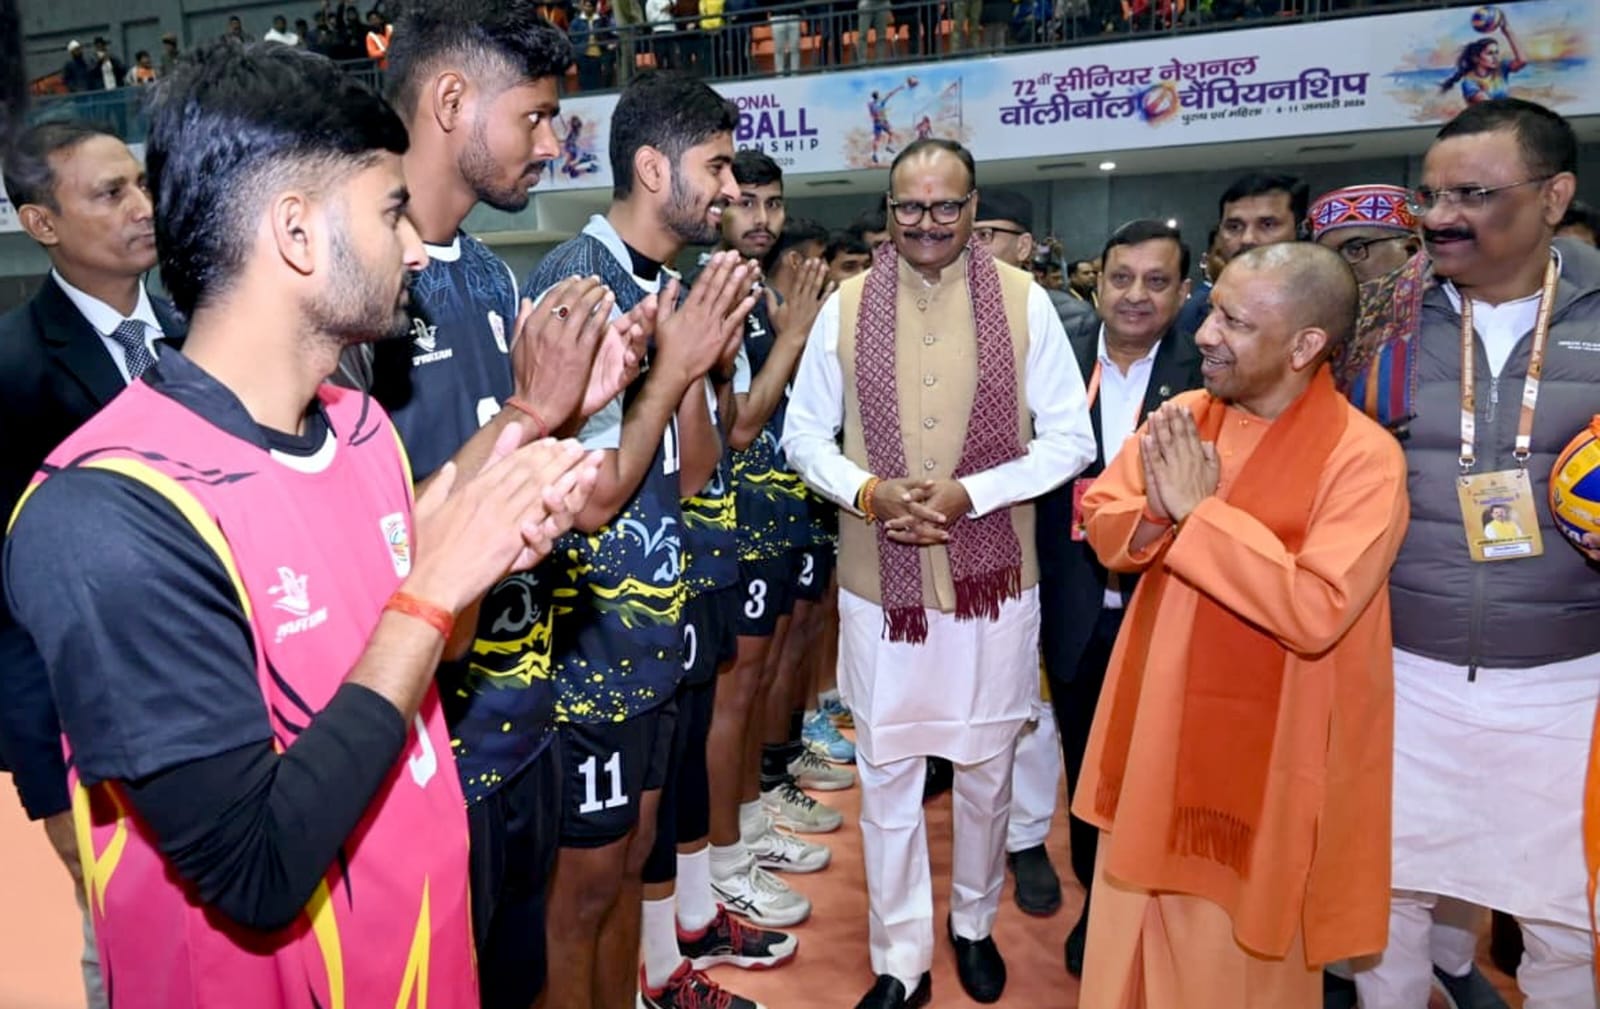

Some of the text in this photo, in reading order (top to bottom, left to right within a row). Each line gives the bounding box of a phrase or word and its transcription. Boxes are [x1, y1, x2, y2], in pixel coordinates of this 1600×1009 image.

[1053, 64, 1153, 93] सीनियर
[1158, 55, 1259, 82] नेशनल
[999, 90, 1138, 126] वॉलीबॉल
[744, 579, 768, 618] 3
[578, 751, 629, 814] 11
